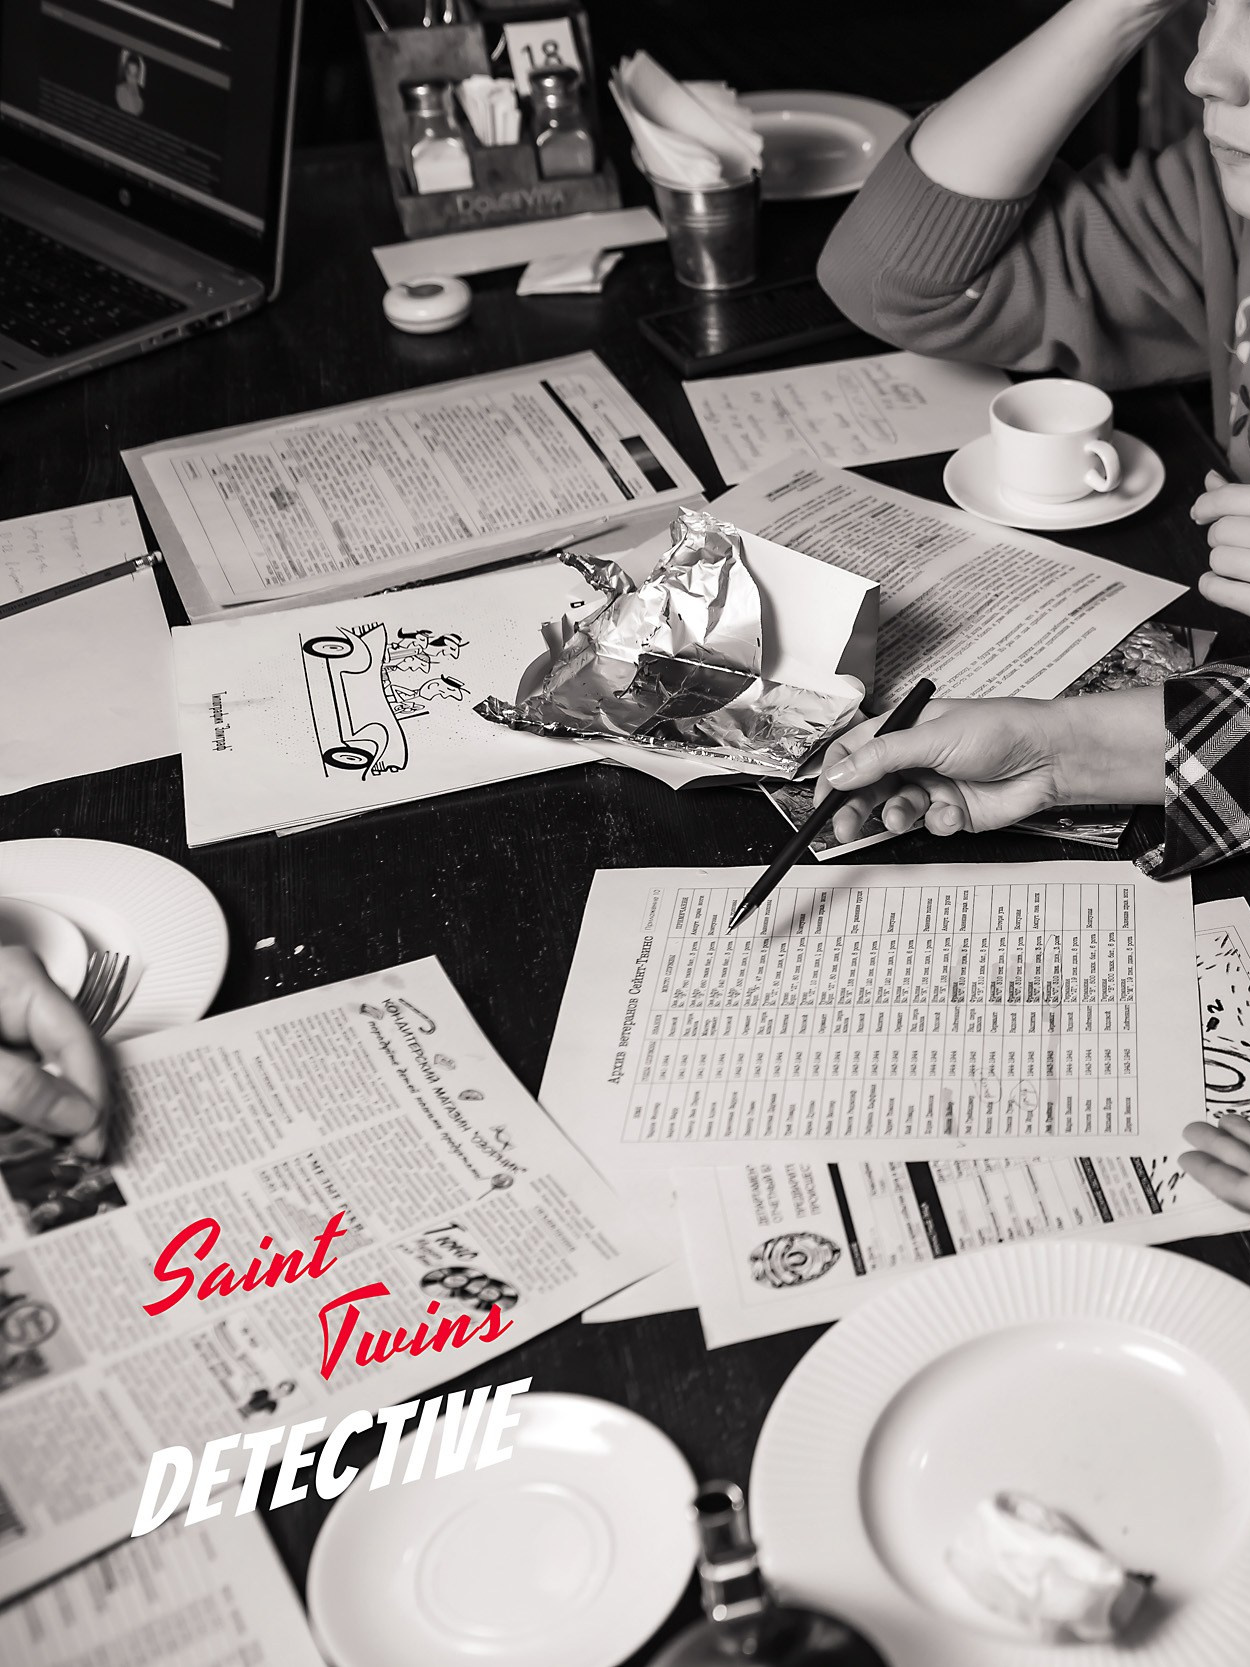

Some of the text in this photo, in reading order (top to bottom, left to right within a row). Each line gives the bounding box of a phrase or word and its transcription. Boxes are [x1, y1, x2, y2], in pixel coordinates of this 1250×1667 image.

[382, 998, 440, 1084] КОНДИТЕРСКИЙ
[433, 1087, 471, 1132] МАГАЗИН
[607, 934, 654, 1085] Архив ветеранов Сейнт-Твинс
